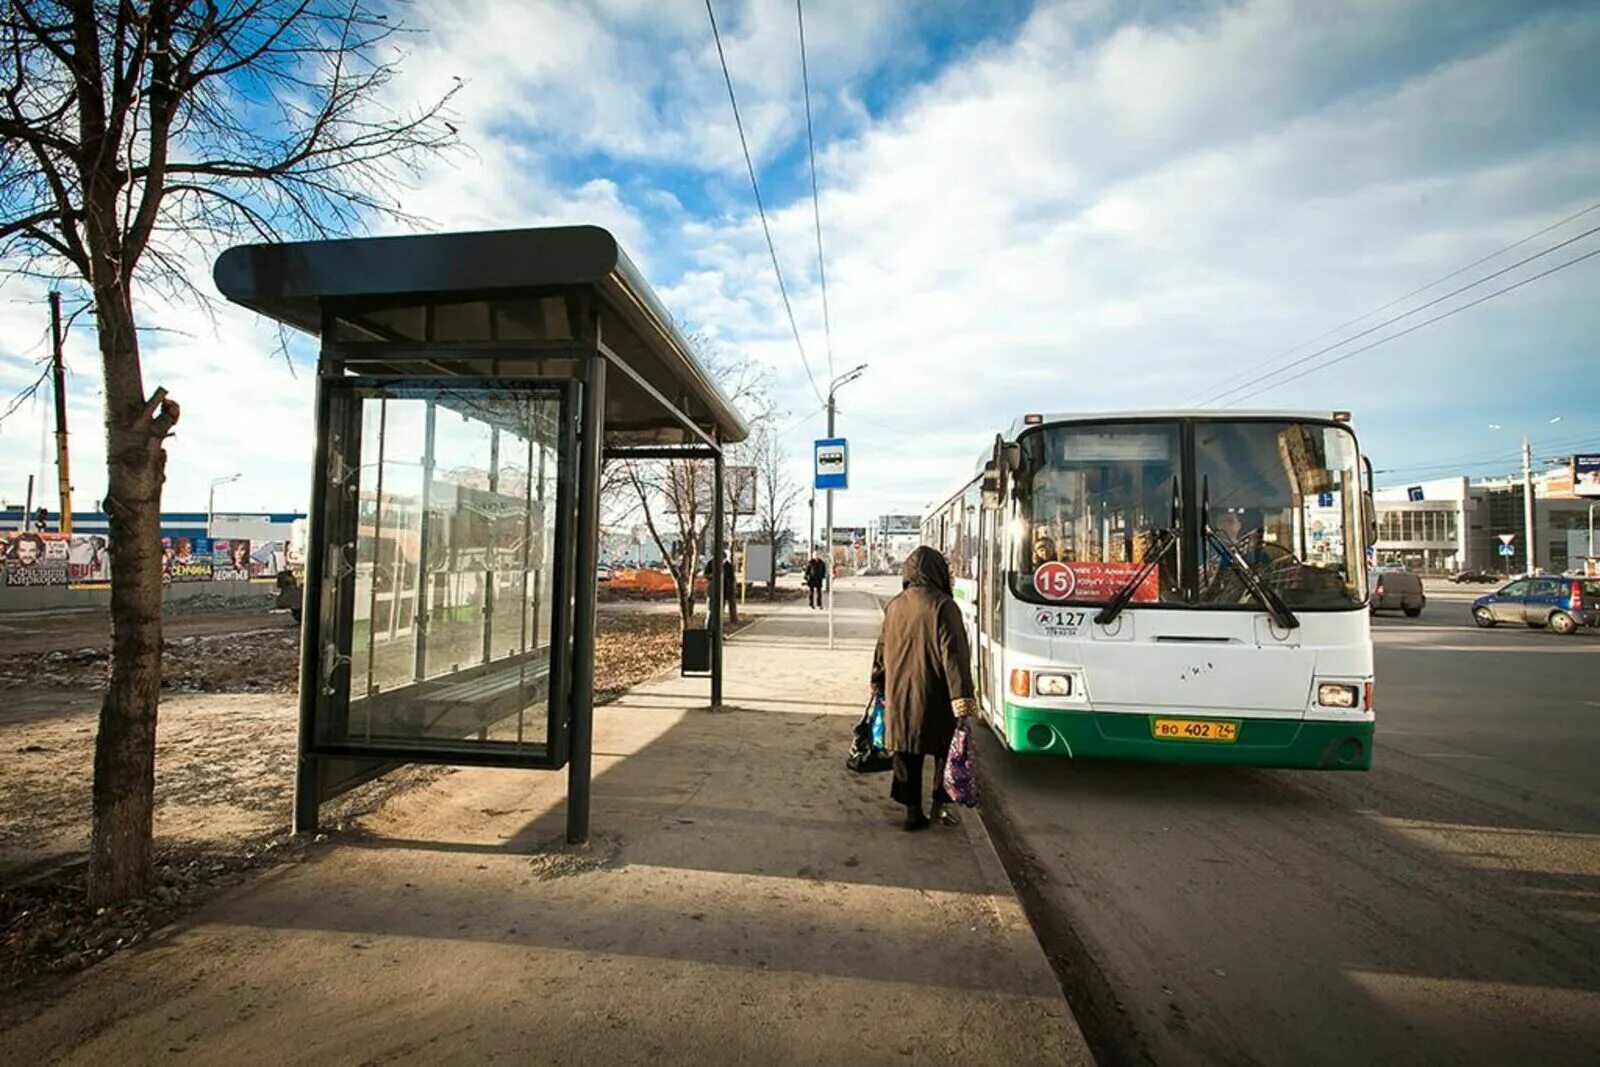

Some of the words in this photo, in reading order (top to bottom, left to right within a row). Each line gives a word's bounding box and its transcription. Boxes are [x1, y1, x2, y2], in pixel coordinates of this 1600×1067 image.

[1040, 571, 1068, 591] 15
[1056, 612, 1085, 626] 127
[1162, 724, 1179, 735] ВО
[1184, 724, 1210, 737] 402
[1218, 724, 1231, 735] 74
